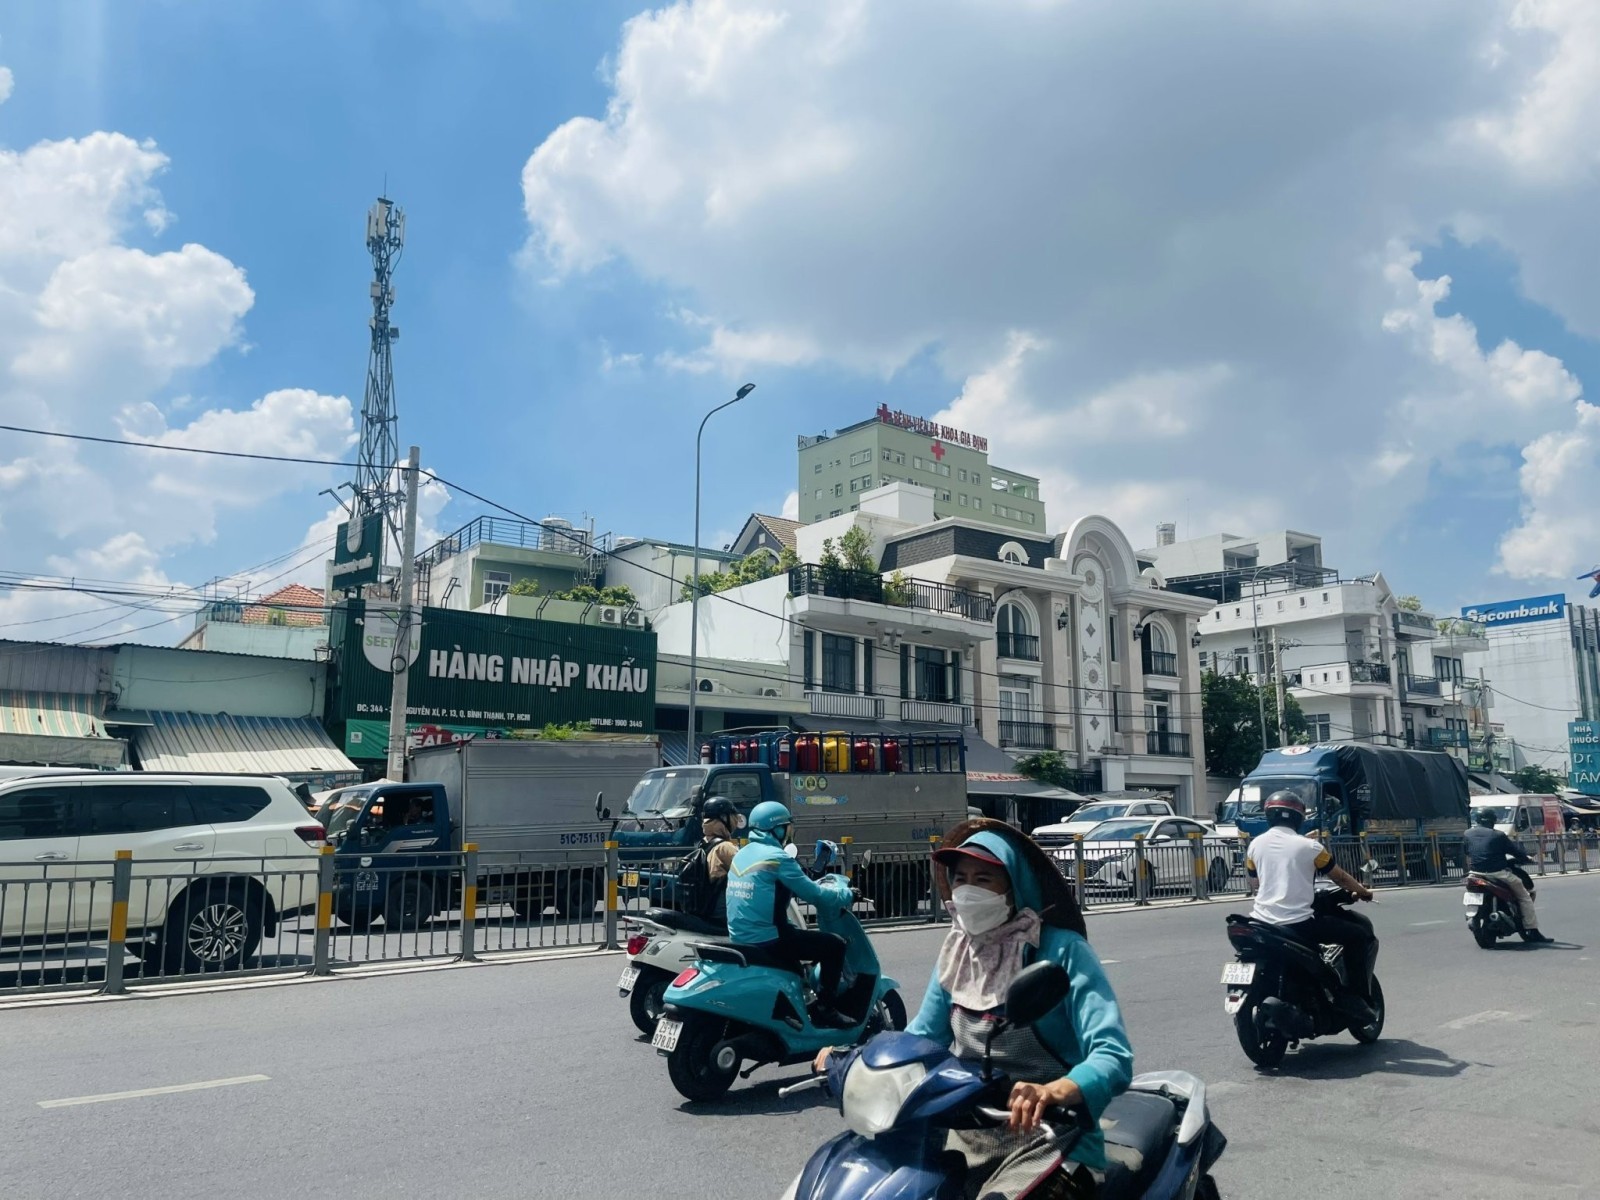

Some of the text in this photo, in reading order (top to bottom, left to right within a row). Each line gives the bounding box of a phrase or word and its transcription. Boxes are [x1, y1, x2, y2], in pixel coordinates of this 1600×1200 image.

[941, 424, 959, 443] KHOA
[960, 430, 971, 447] GIA
[1466, 600, 1559, 623] Sacombank
[429, 644, 649, 693] HÀNG NHẬP KHẤU
[370, 704, 384, 713] 344
[441, 709, 448, 717] P.
[506, 712, 516, 721] TP.
[589, 717, 643, 728] HOTLINE: 1900 3445
[1573, 723, 1592, 733] NHÀ
[1569, 733, 1599, 744] THUỐC
[1573, 752, 1593, 764] Dr.
[559, 831, 606, 845] 51C-751.18
